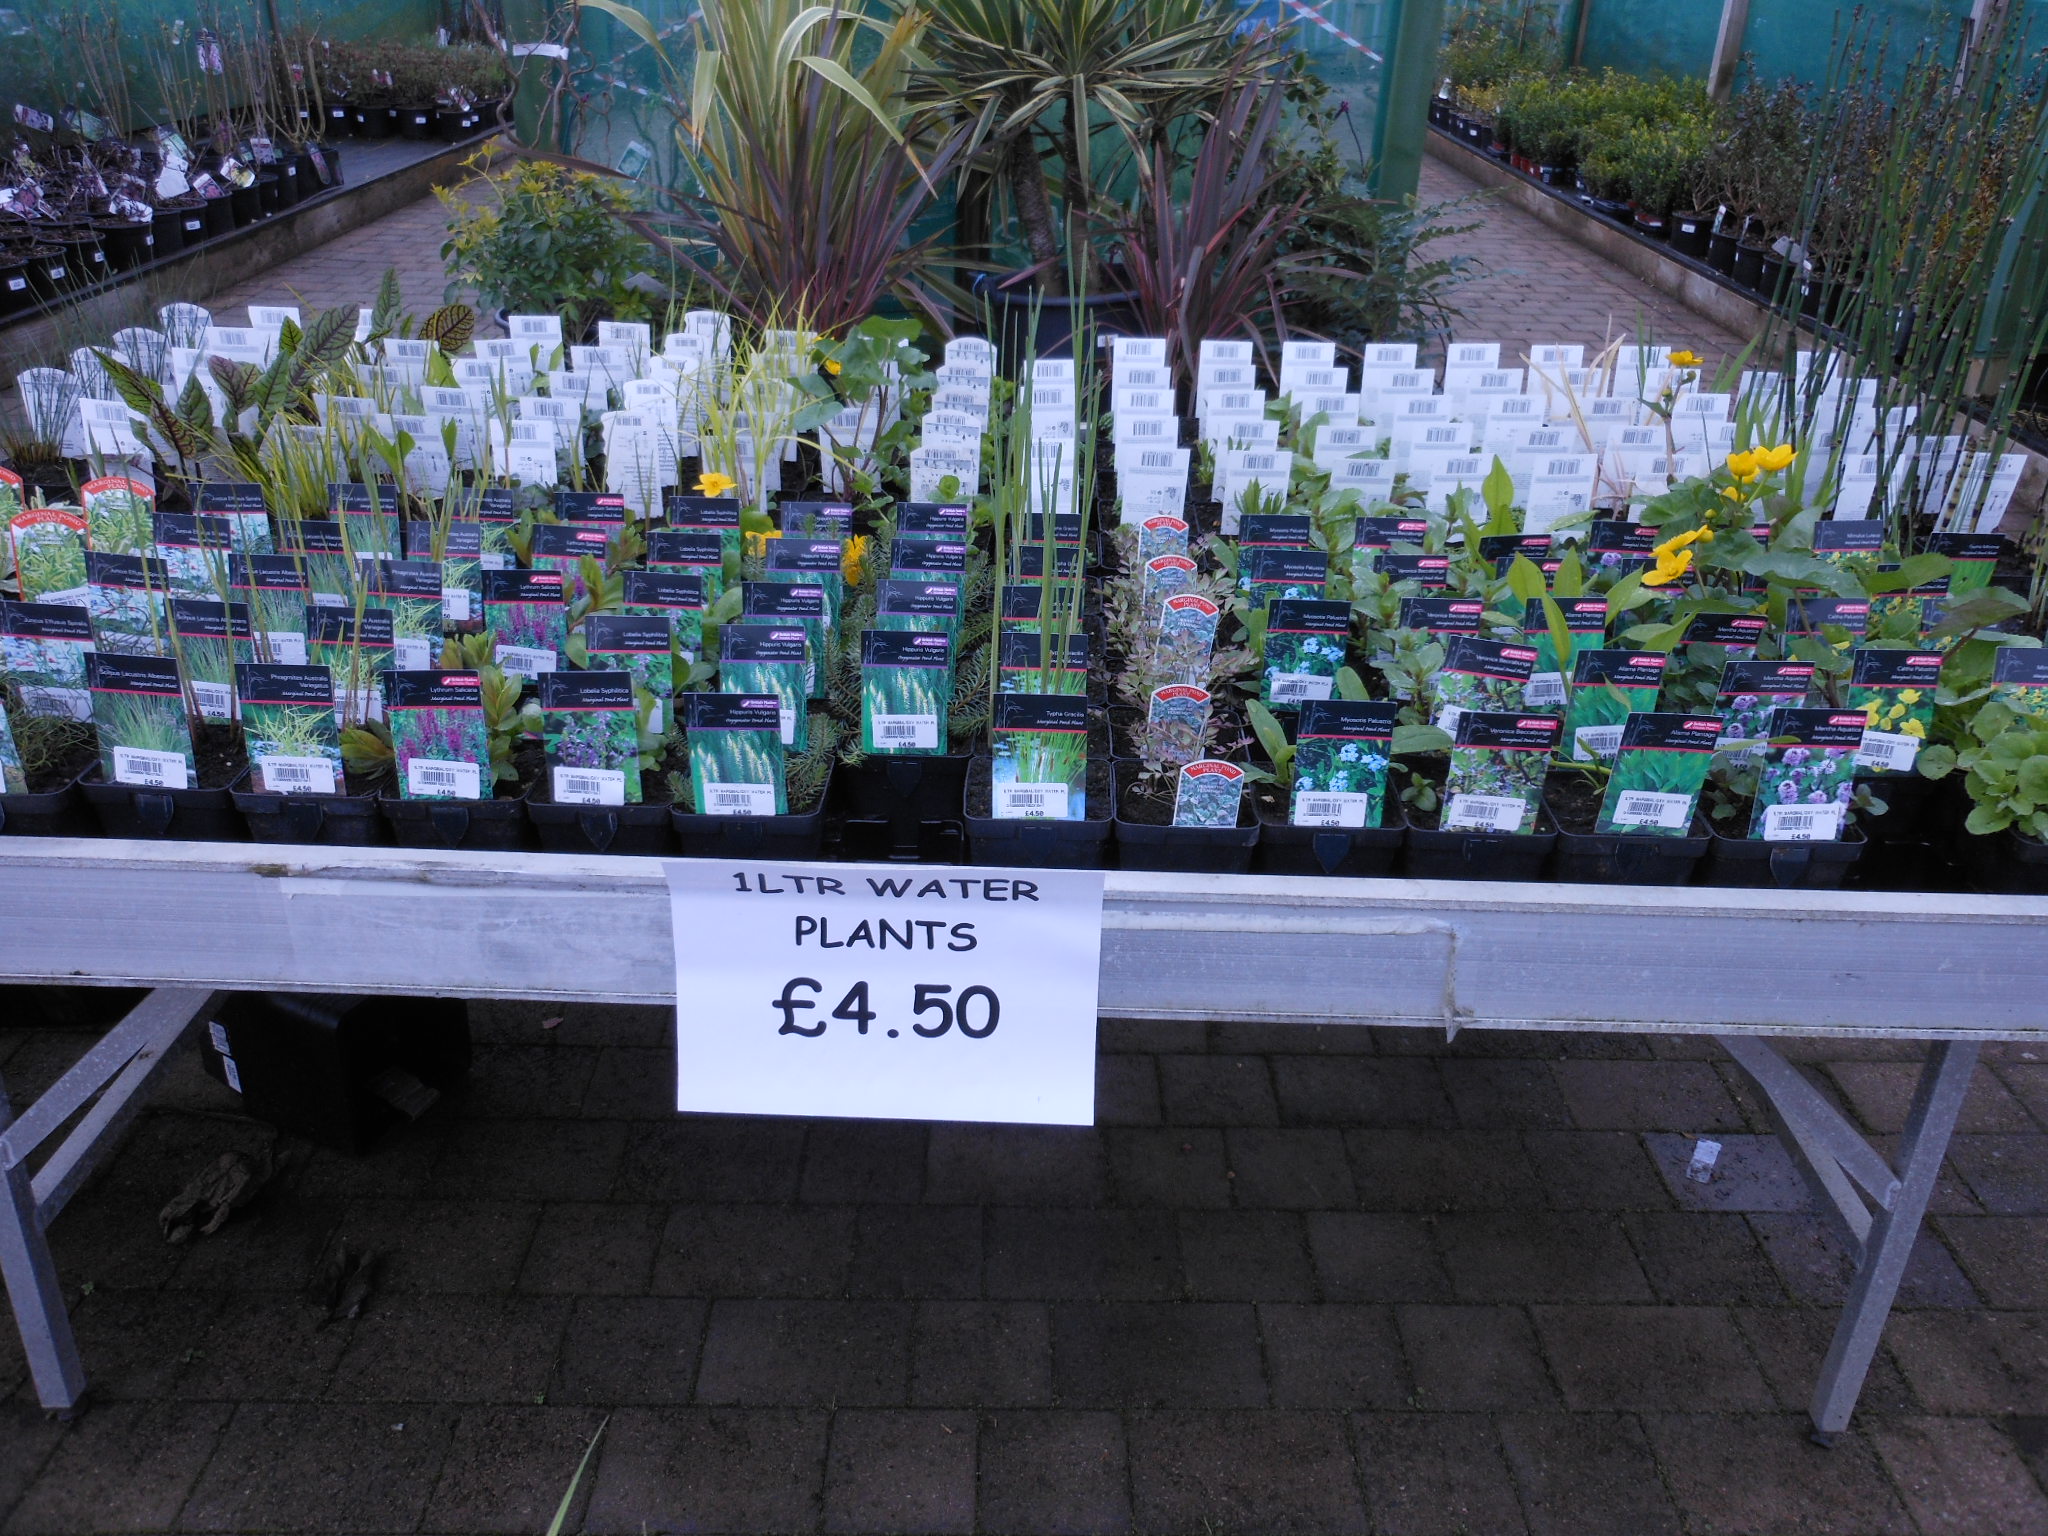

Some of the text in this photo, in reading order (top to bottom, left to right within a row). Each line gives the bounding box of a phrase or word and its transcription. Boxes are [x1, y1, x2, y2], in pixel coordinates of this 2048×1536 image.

[14, 511, 82, 526] MARGINAL POND
[429, 686, 454, 695] Lythrum
[579, 687, 630, 696] Lobelia Syphilitica
[1190, 763, 1220, 772] MARGINAL
[732, 872, 1040, 902] 1LTR WATER
[795, 915, 978, 952] PLANTS
[772, 977, 1001, 1039] £4.50
